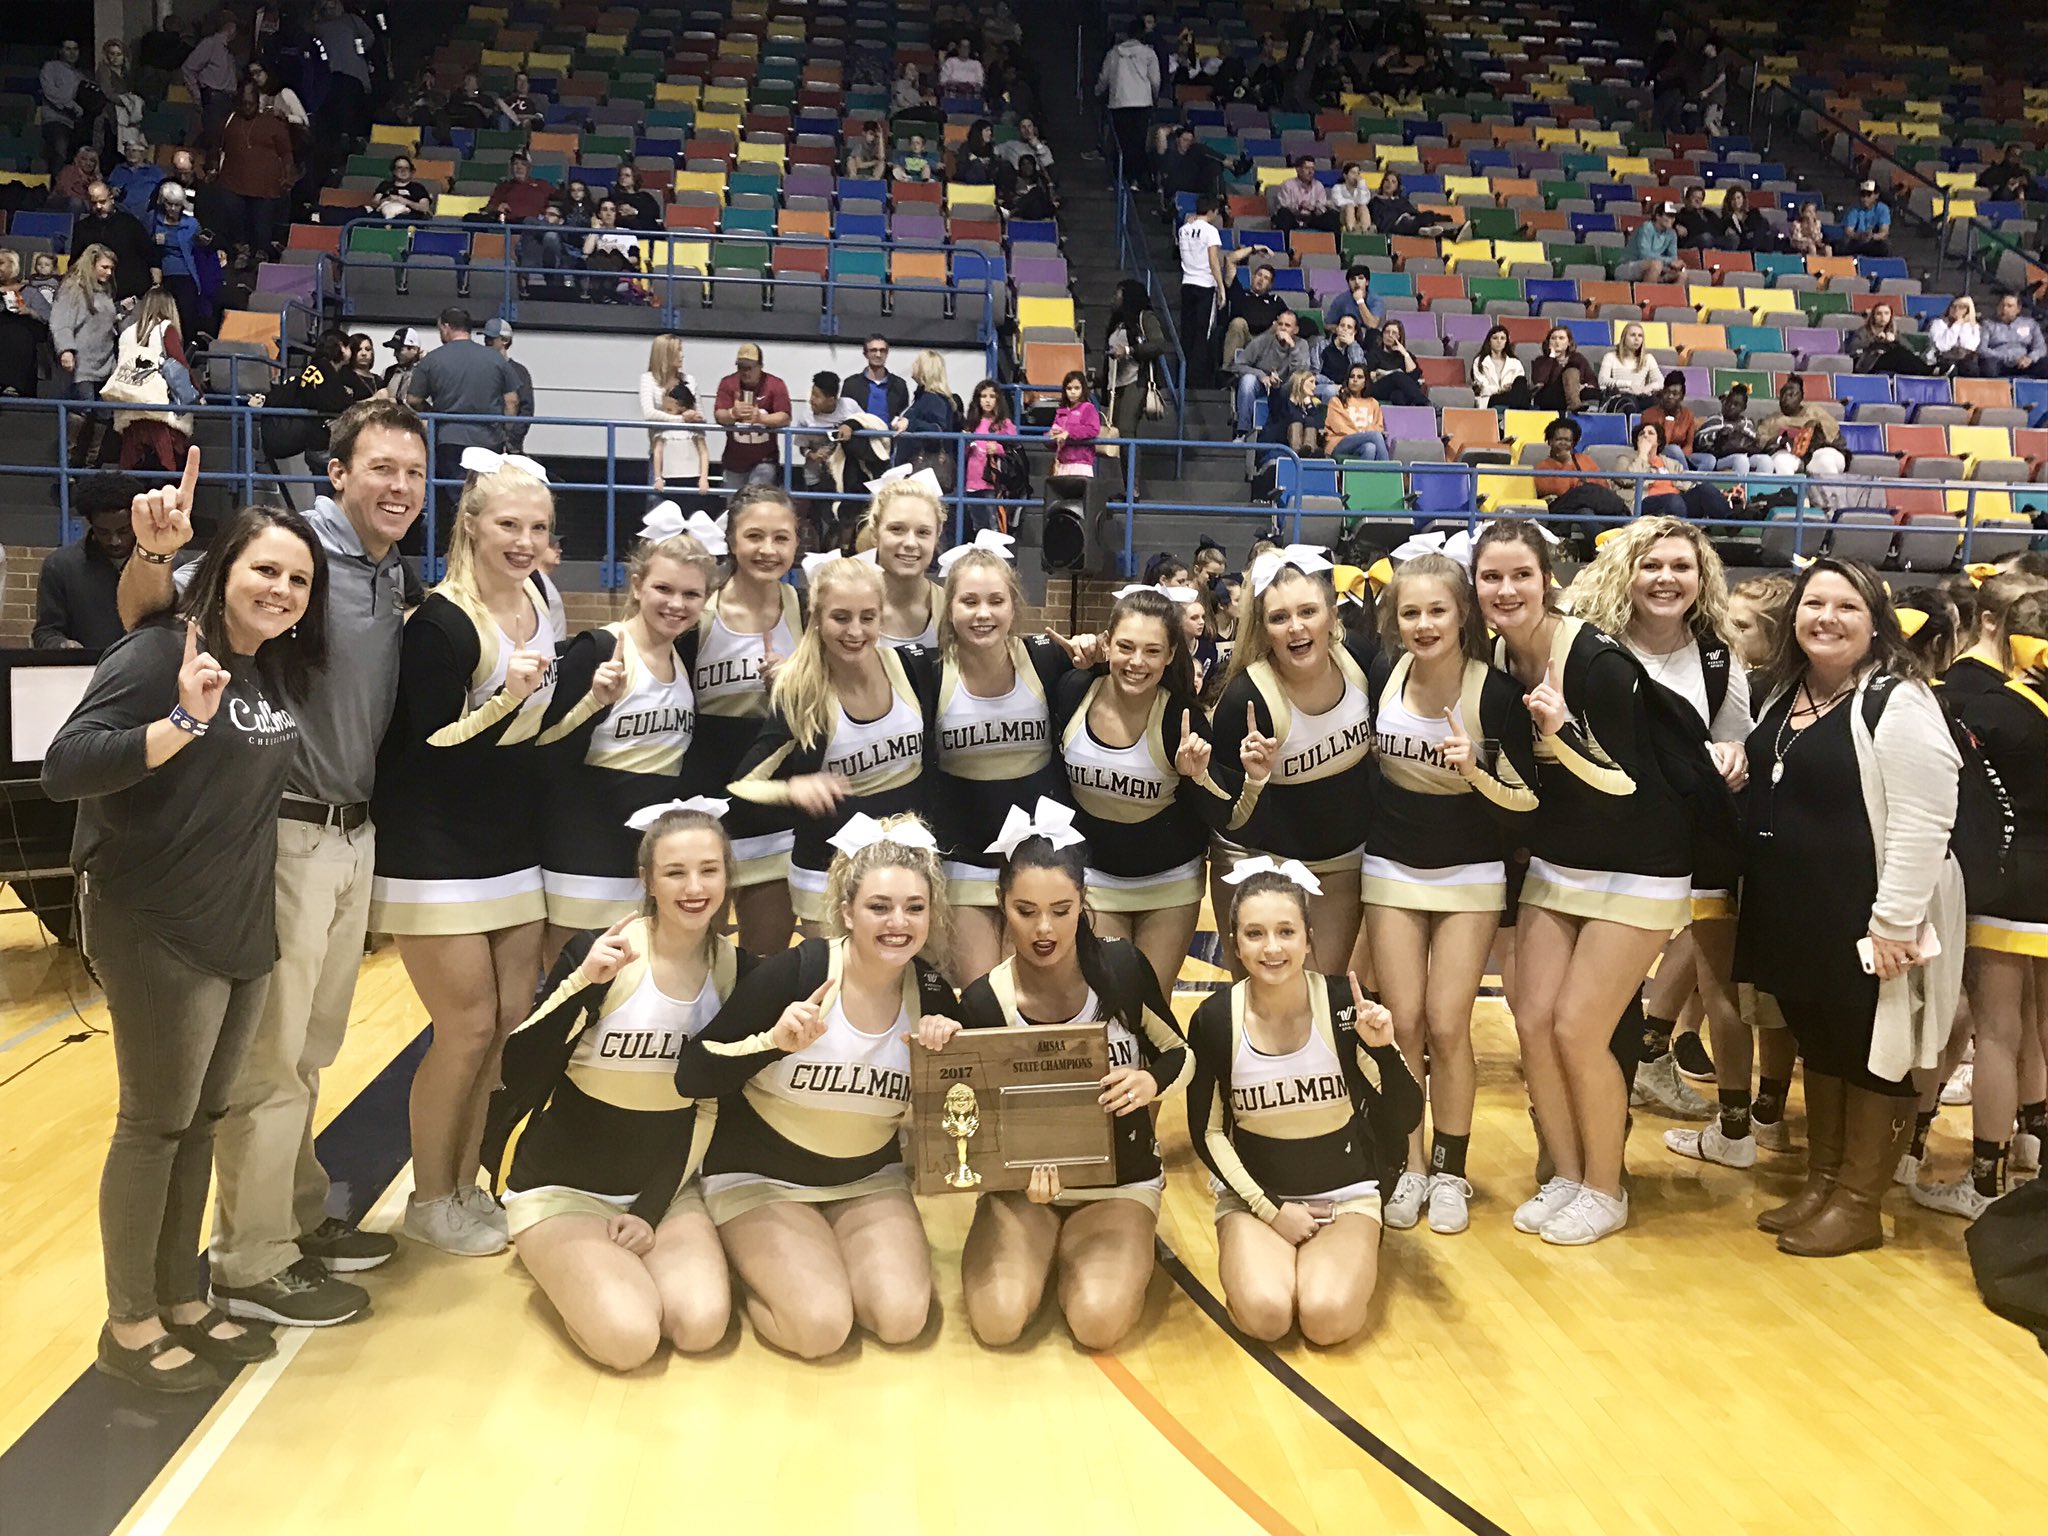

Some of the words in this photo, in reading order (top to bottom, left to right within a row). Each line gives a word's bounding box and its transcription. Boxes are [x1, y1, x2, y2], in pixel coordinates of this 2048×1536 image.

[697, 658, 764, 690] CULL
[229, 698, 296, 733] Cullma
[615, 707, 695, 739] CULLMA
[942, 720, 1046, 750] CULLMAN
[1284, 718, 1370, 777] CULLMA
[1376, 732, 1460, 772] ULLM
[1066, 763, 1162, 799] ULLMAN
[601, 1032, 690, 1060] CULL
[1037, 1040, 1066, 1052] AHSAA
[939, 1066, 973, 1080] 2017
[1013, 1061, 1039, 1073] STATE
[1041, 1058, 1093, 1072] CHAMPIONS
[790, 1064, 911, 1102] CULLMAN
[1232, 1075, 1347, 1111] CULLMAN
